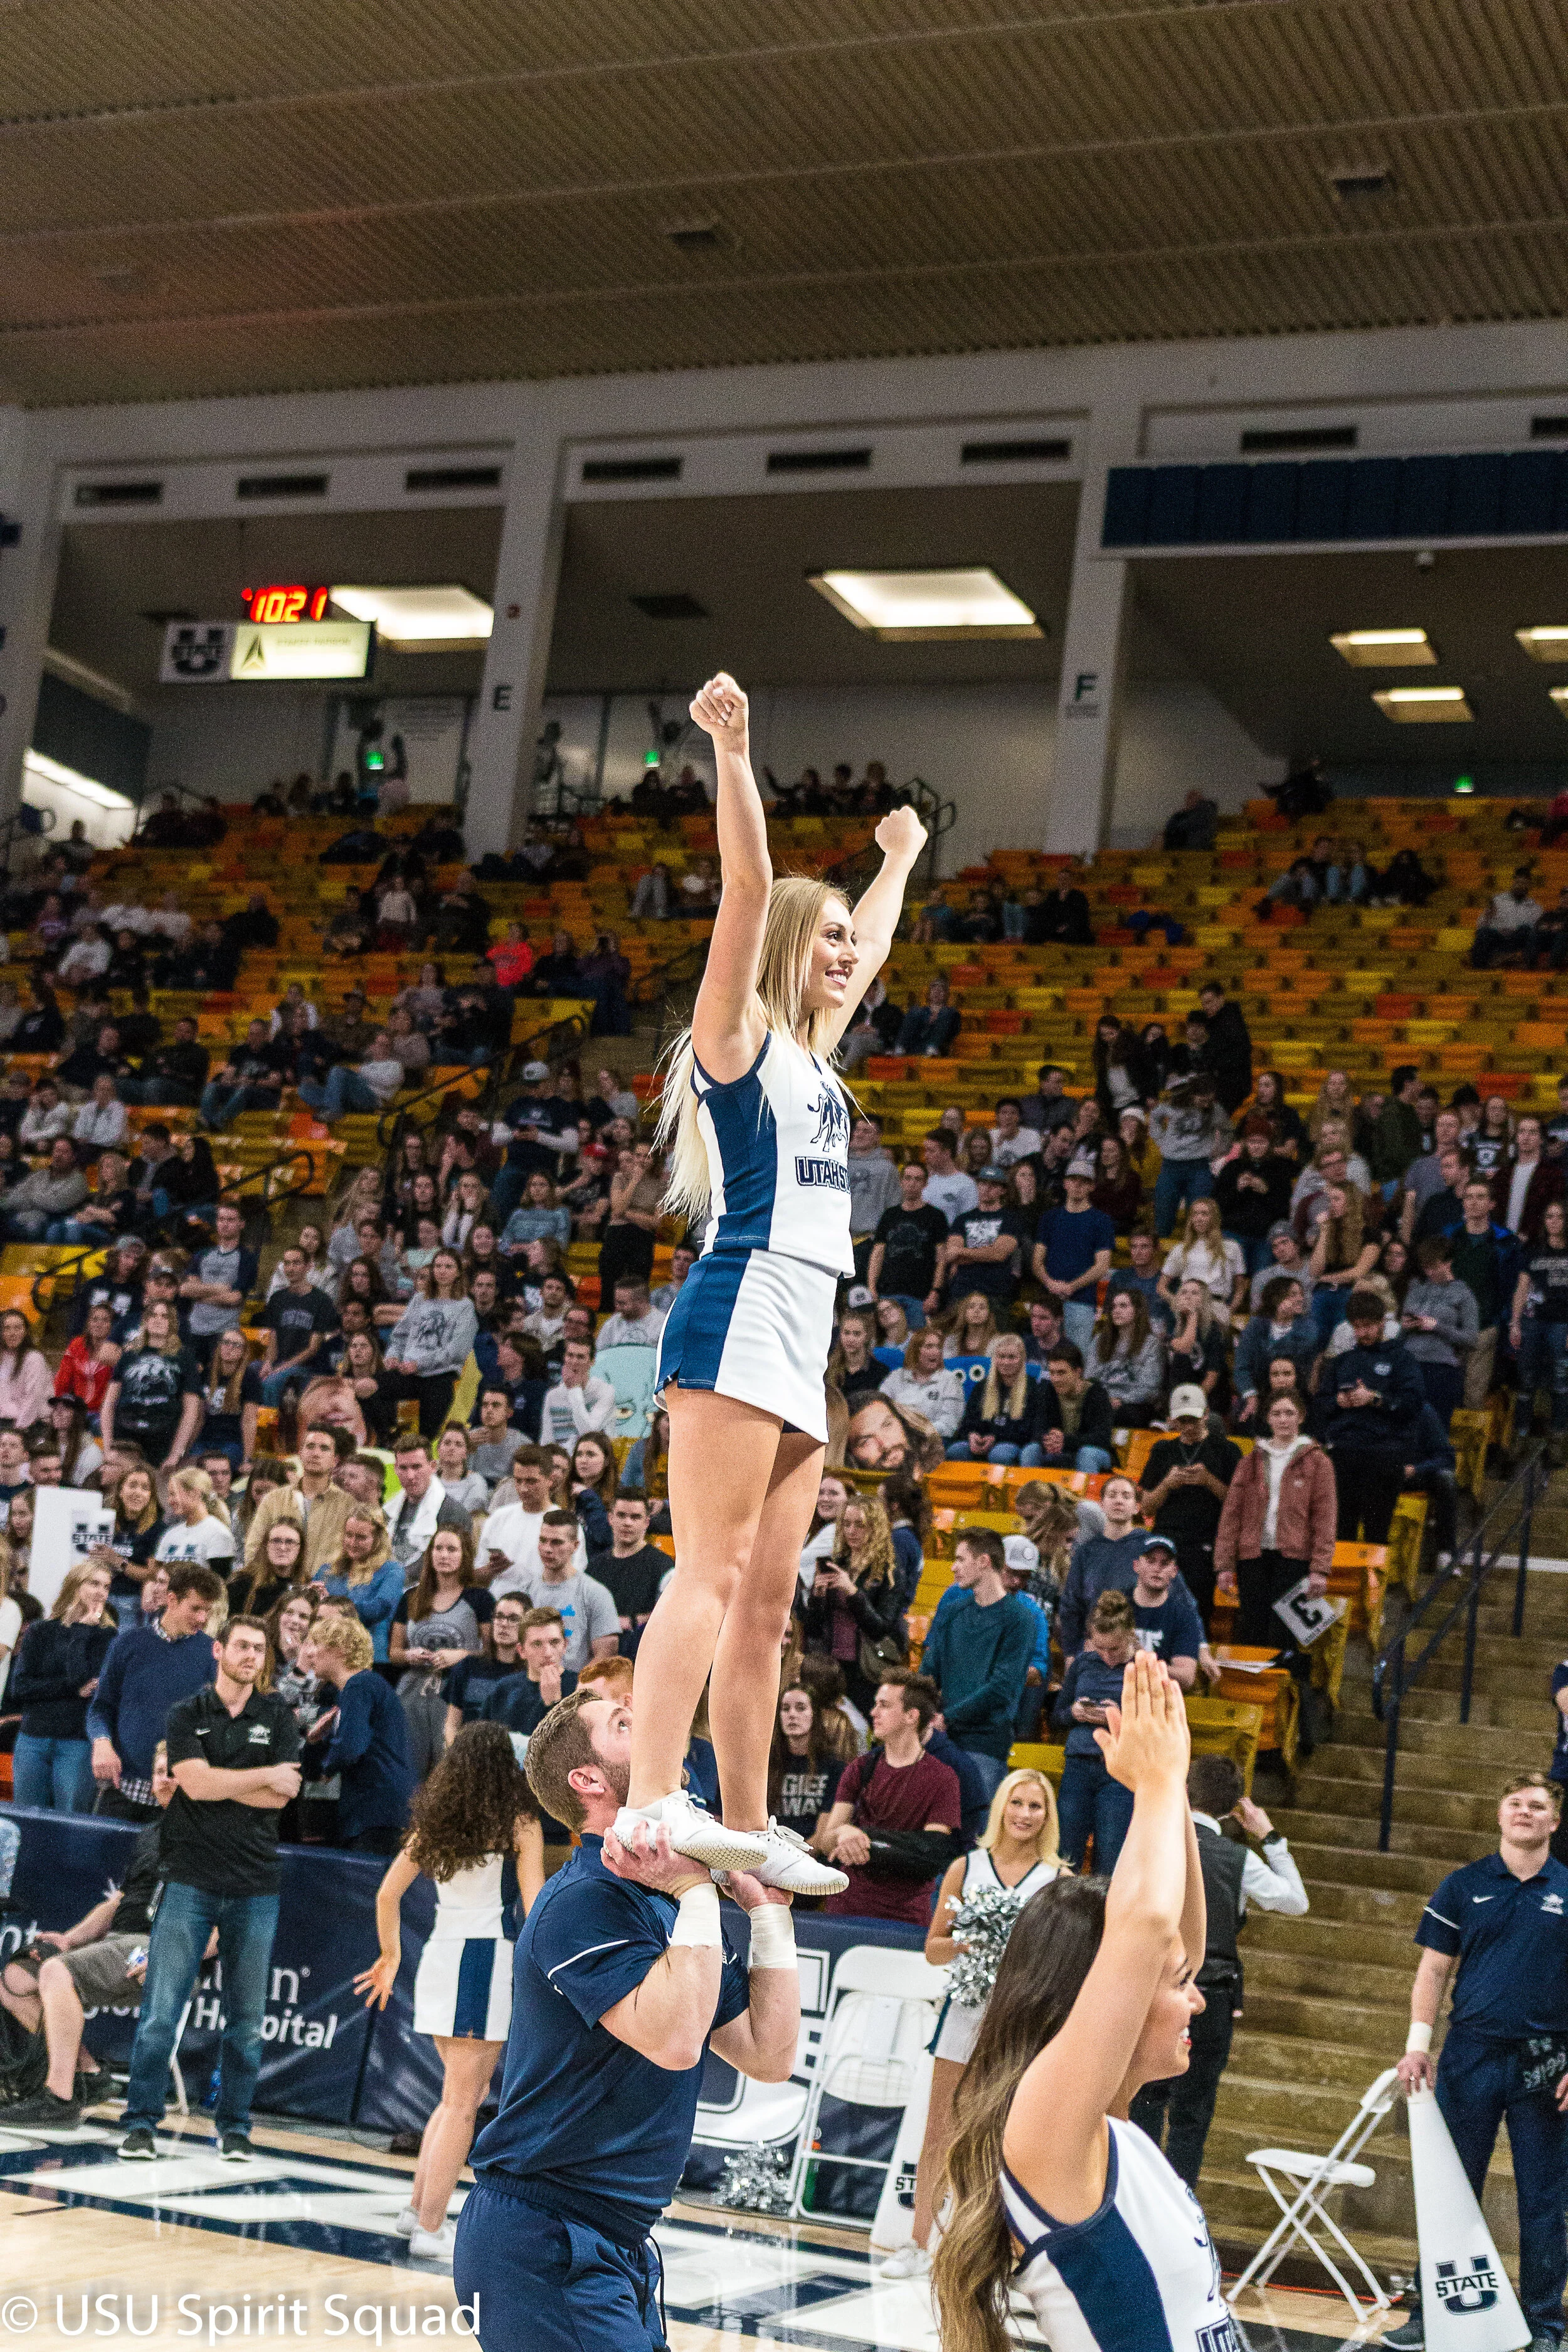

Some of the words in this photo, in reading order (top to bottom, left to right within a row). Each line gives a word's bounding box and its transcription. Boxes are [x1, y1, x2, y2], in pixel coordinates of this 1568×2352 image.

[493, 684, 512, 711] E
[1075, 673, 1099, 702] F
[194, 1996, 337, 2049] Hpital
[1435, 2272, 1499, 2298] STATE
